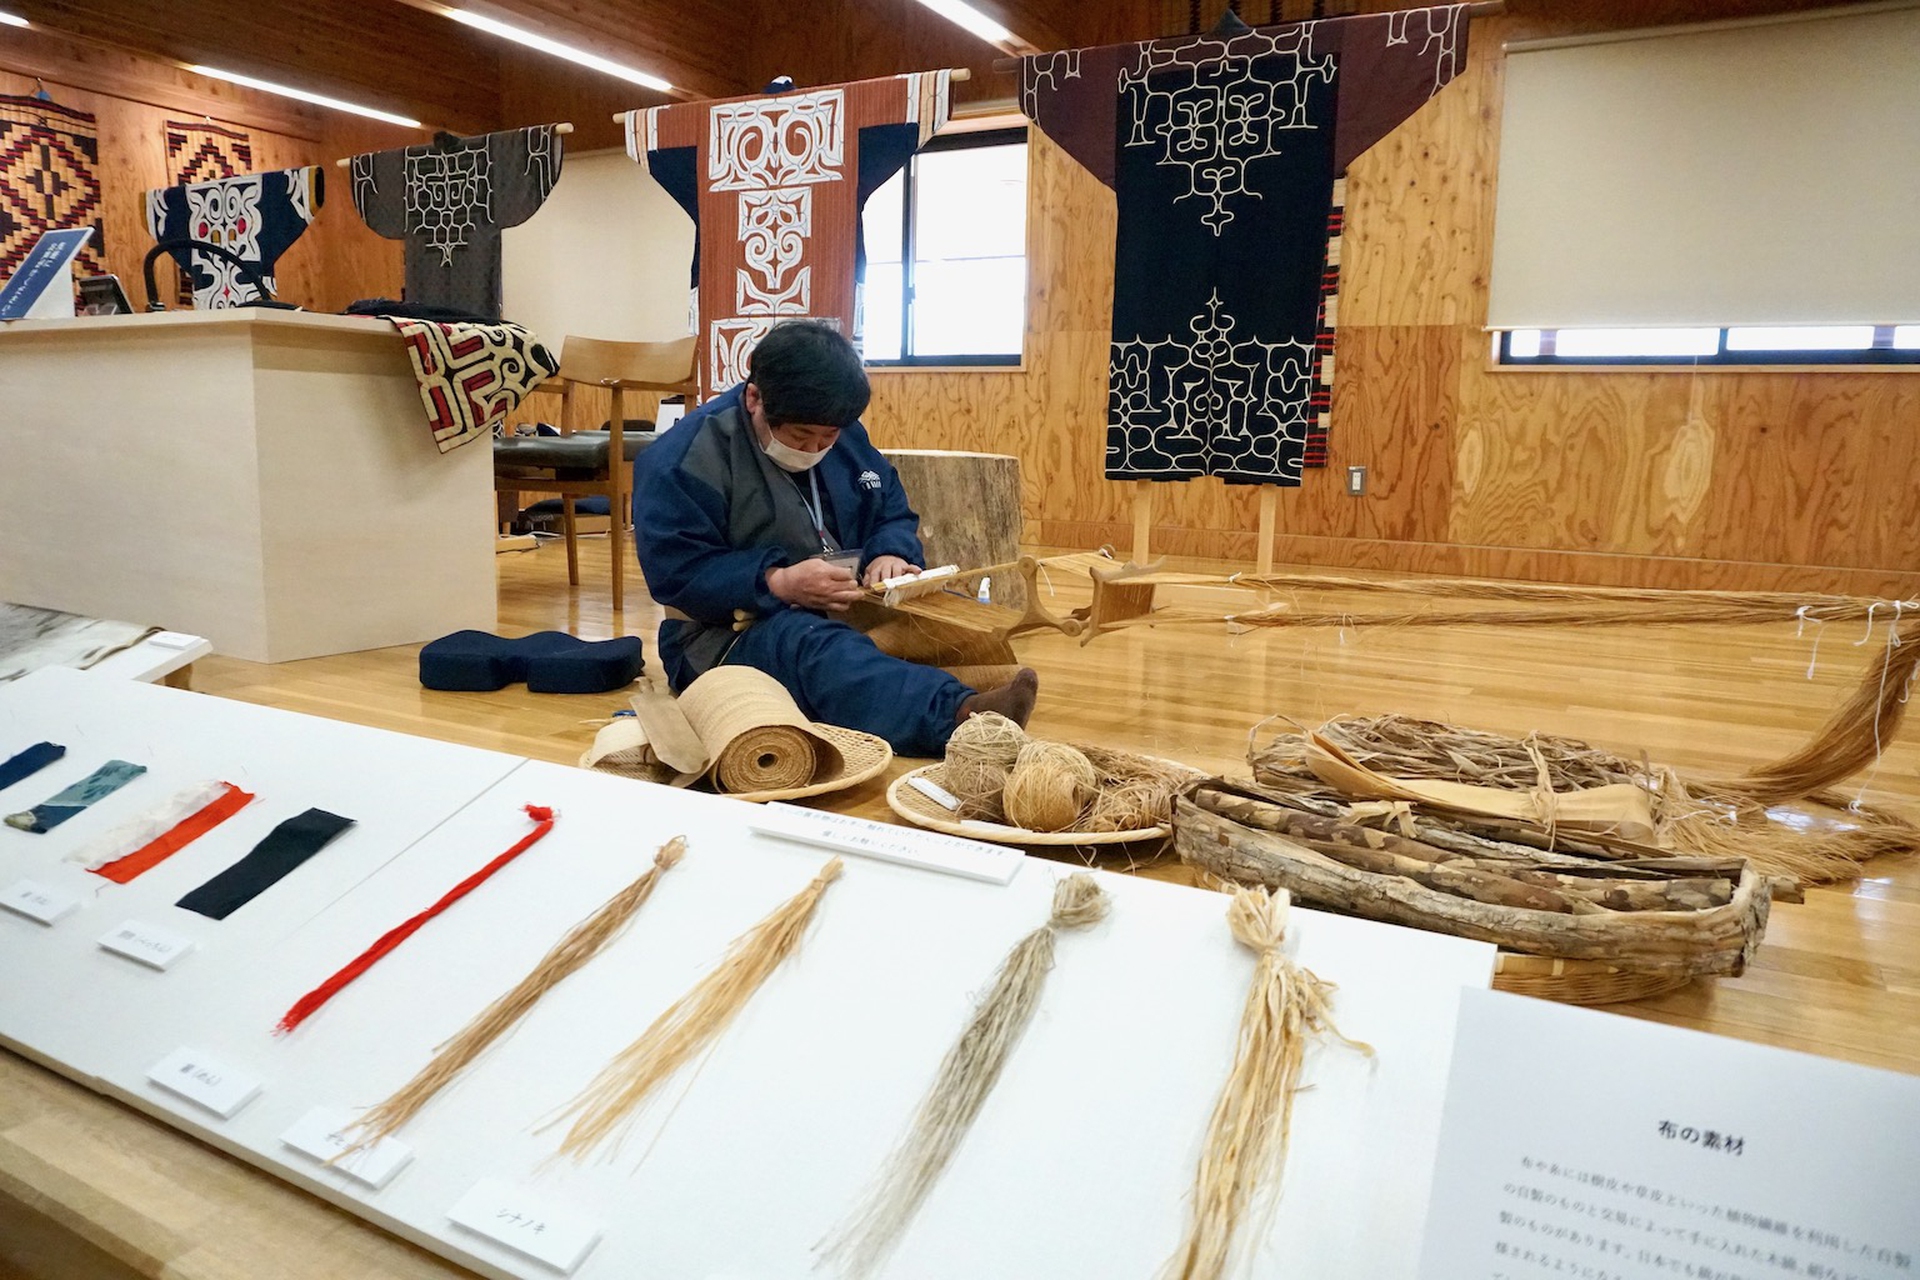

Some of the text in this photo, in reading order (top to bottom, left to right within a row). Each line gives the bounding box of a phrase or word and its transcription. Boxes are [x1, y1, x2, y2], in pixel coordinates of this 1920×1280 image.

[1658, 1119, 1744, 1156] 布の素材
[496, 1208, 546, 1234] シナノキ
